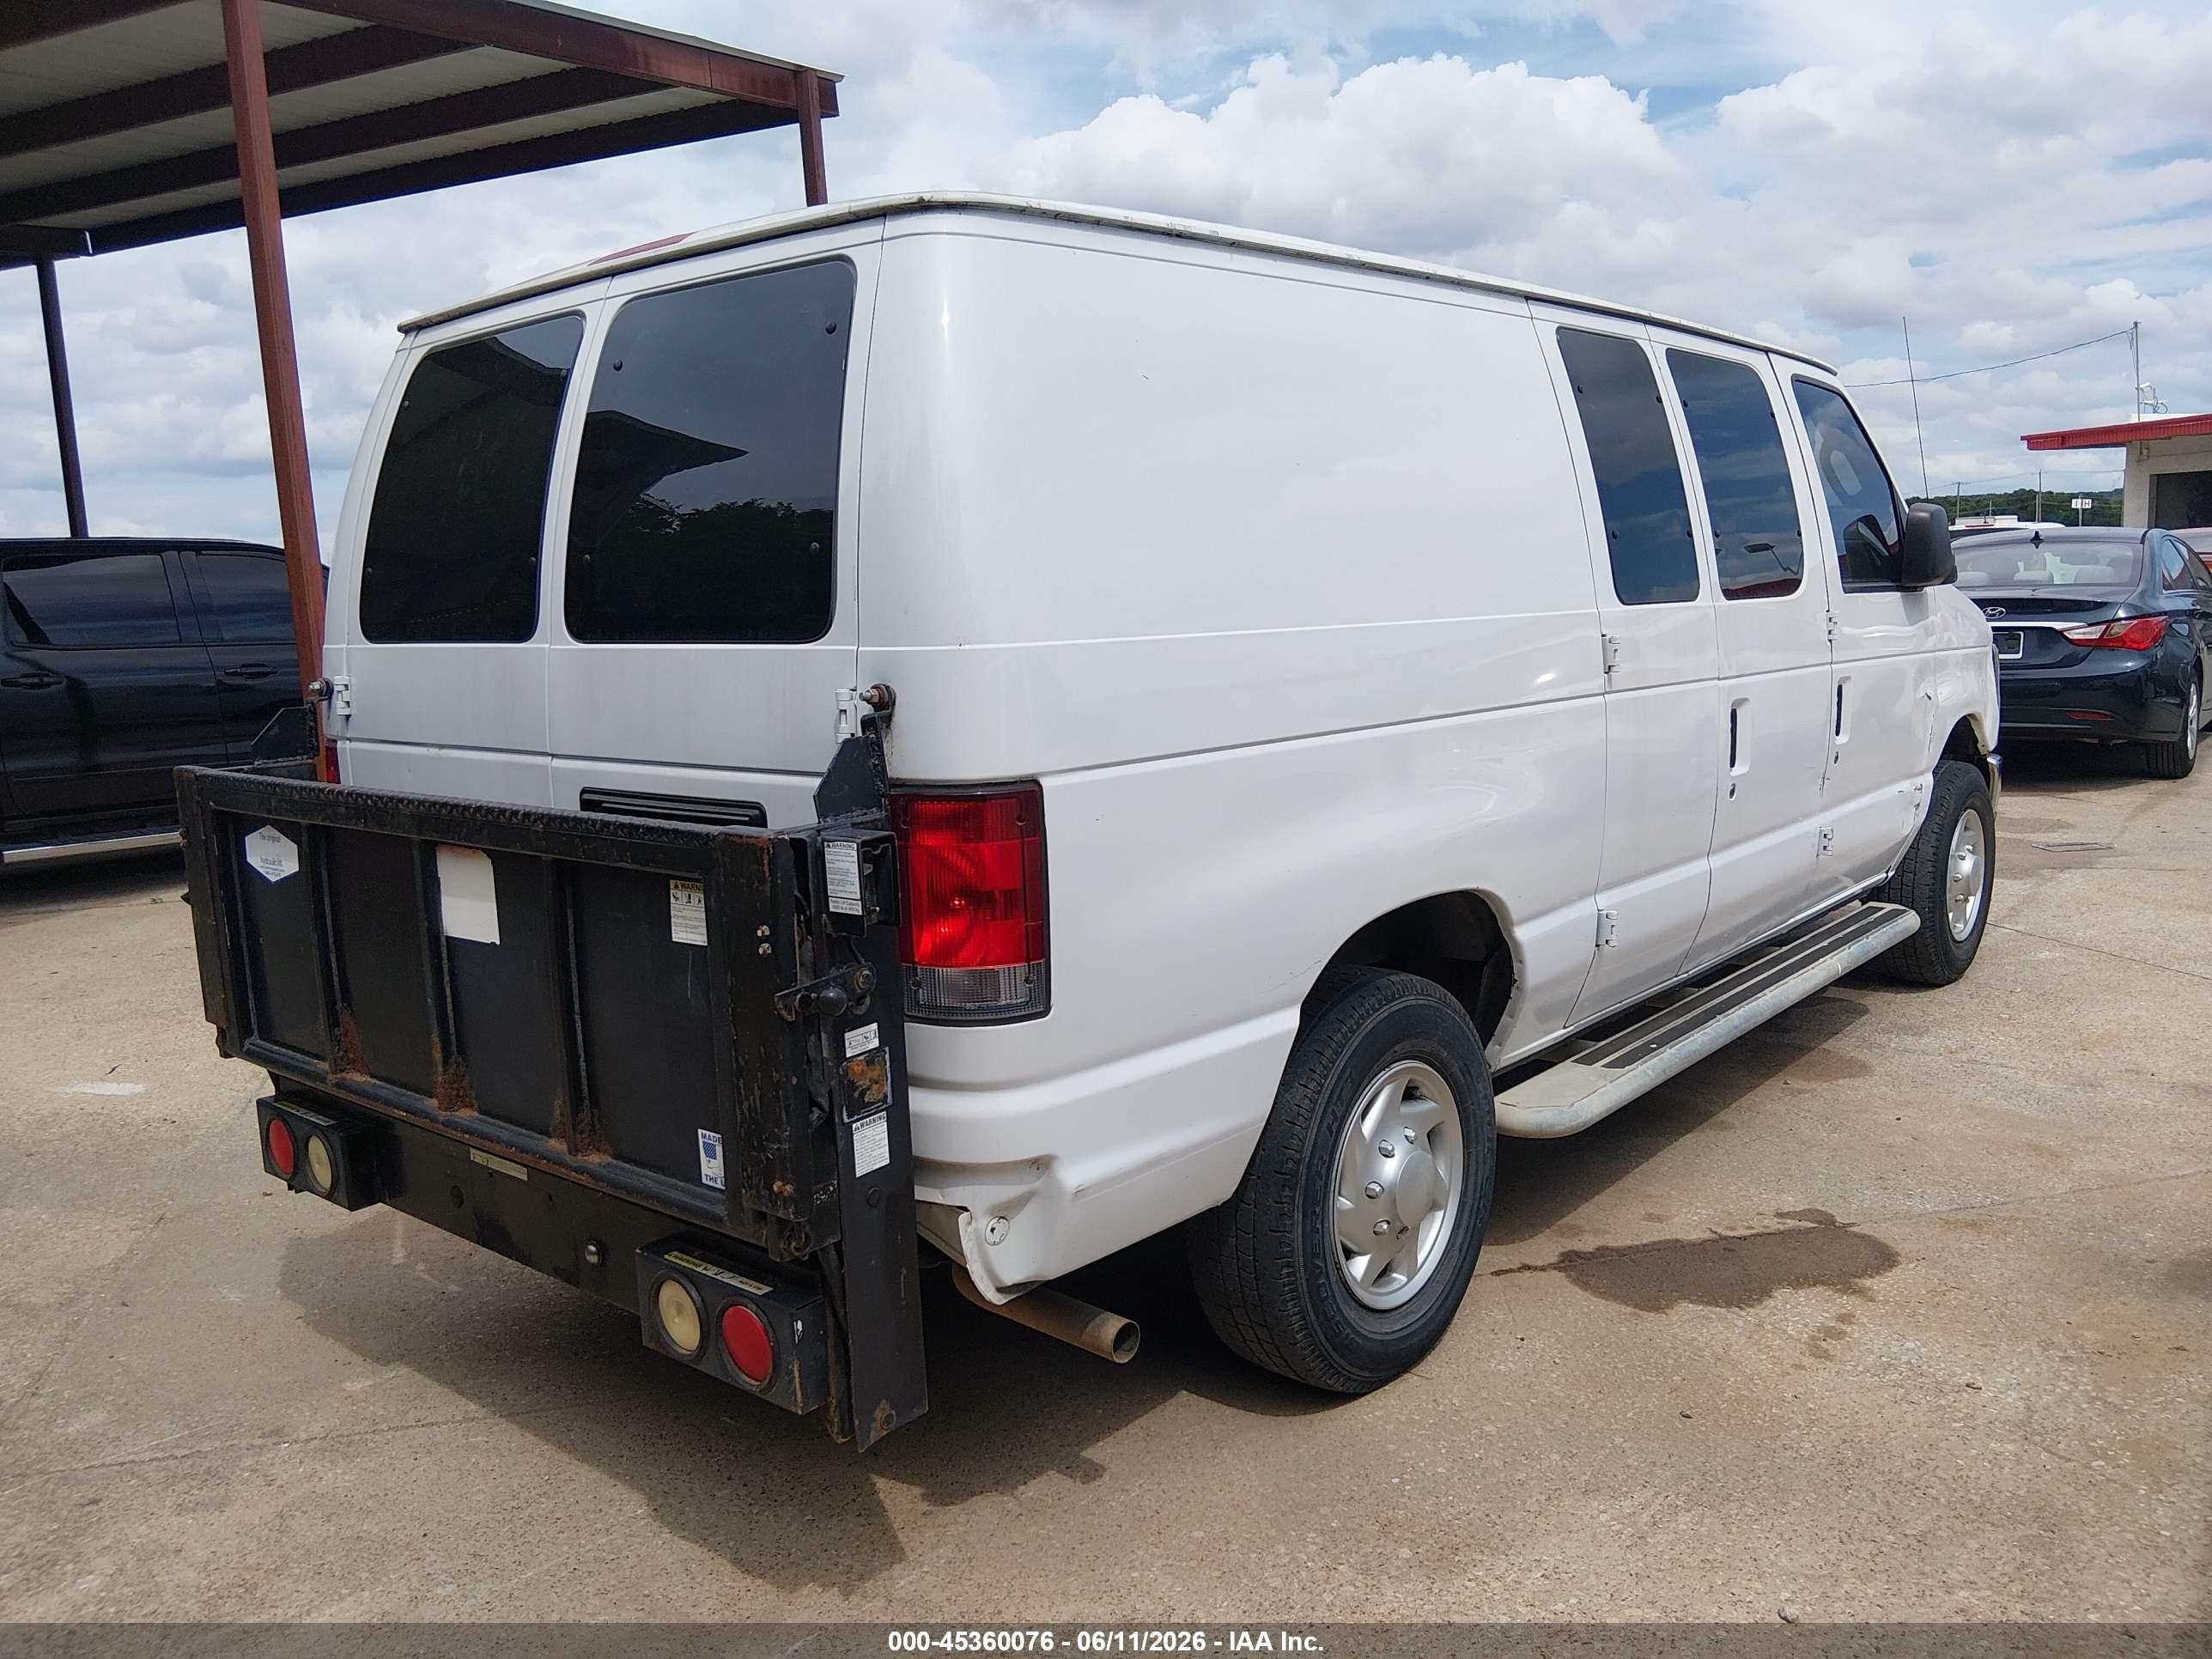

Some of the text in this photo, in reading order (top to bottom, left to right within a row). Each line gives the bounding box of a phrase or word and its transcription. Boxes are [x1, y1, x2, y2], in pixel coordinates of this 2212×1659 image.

[860, 1113, 886, 1128] WARNING
[701, 1132, 723, 1145] MADE
[704, 1174, 720, 1185] THE
